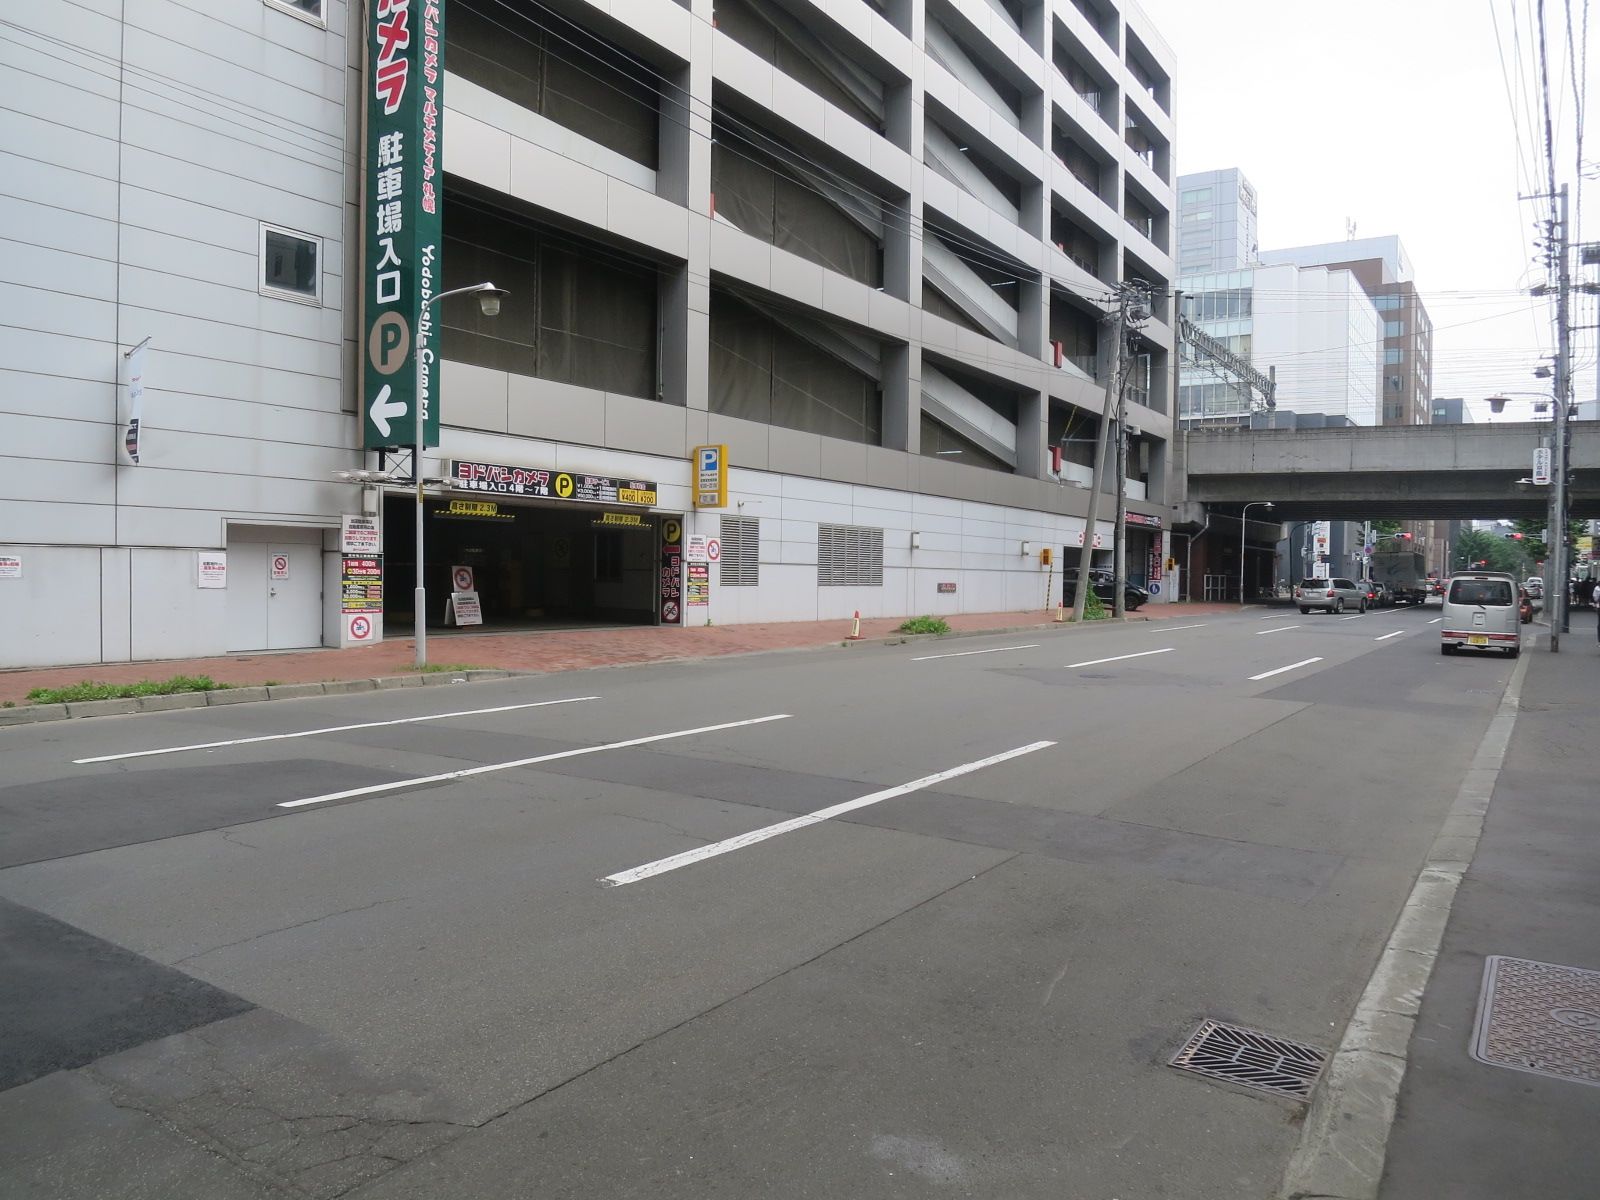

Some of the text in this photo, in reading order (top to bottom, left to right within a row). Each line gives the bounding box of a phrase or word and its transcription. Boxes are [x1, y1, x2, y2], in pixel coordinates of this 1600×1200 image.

[424, 0, 440, 84] バシカメラ
[376, 131, 404, 304] 駐車場入口
[458, 463, 550, 487] ヨドバシカメラ
[459, 480, 508, 493] 駐車場入口
[662, 567, 671, 597] カメラ
[671, 556, 680, 597] ヨドバシ
